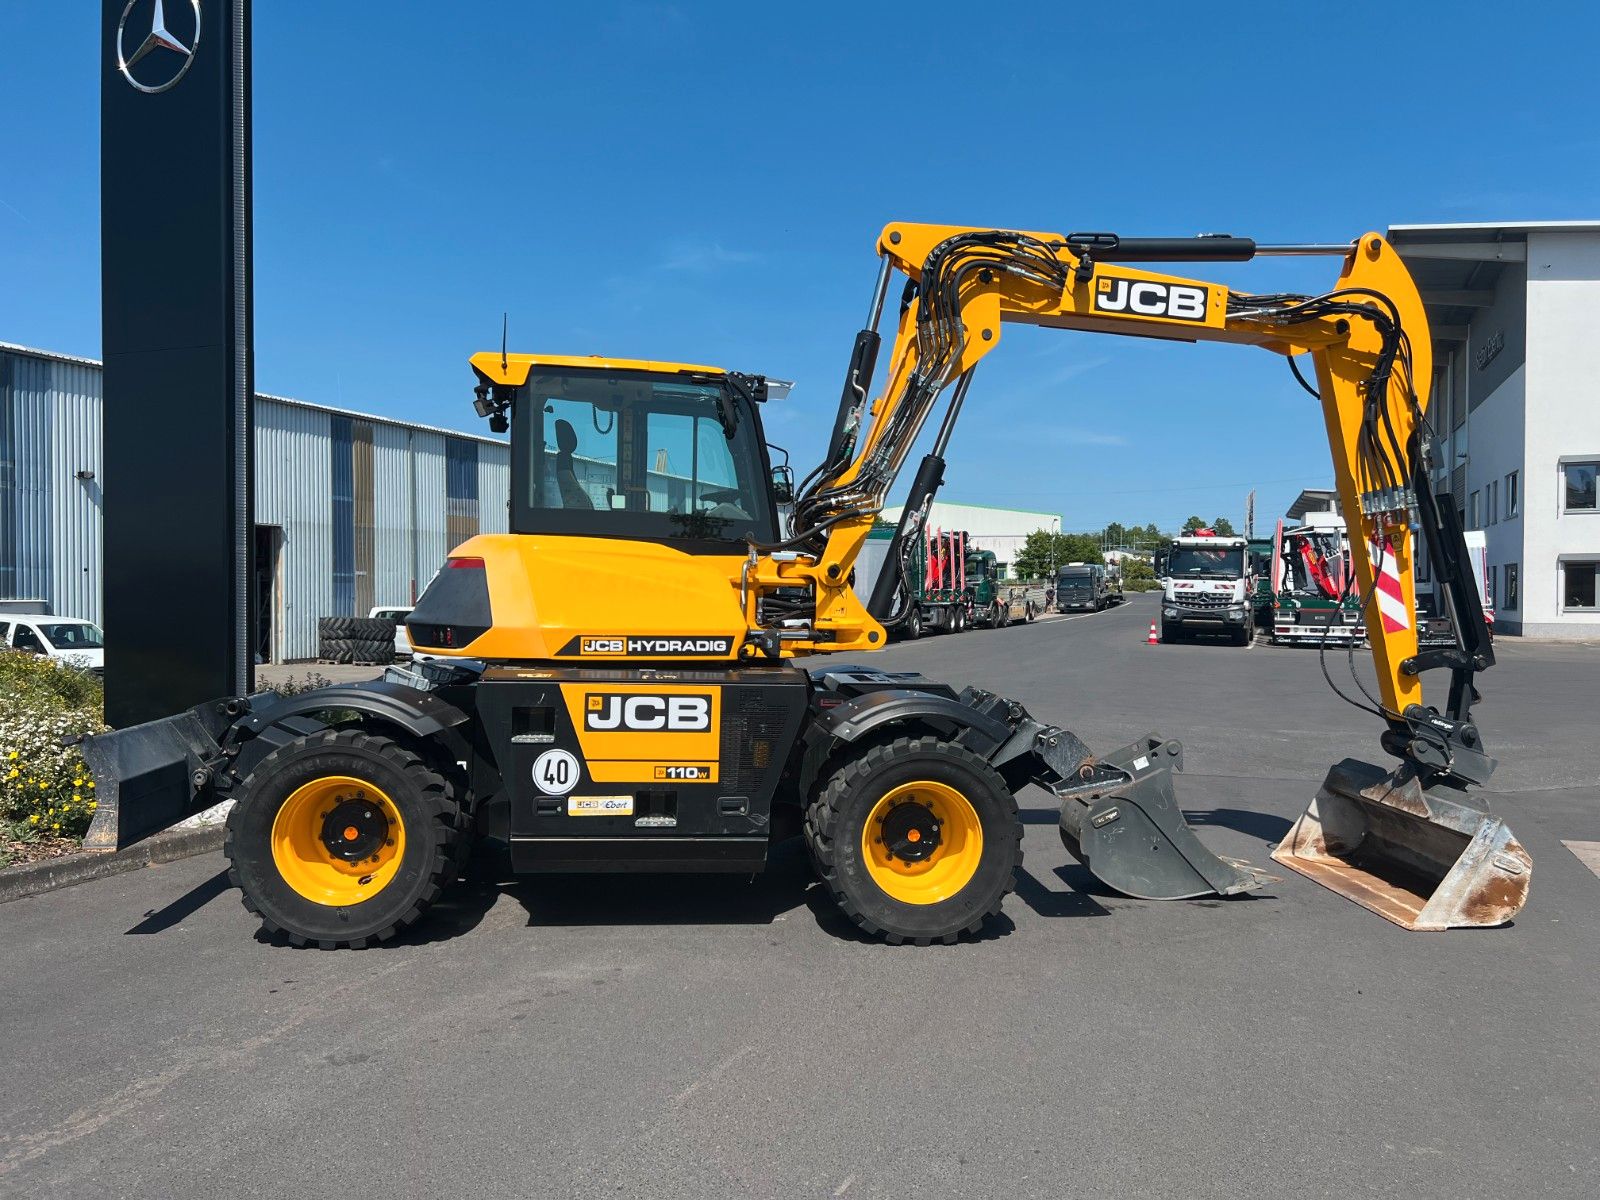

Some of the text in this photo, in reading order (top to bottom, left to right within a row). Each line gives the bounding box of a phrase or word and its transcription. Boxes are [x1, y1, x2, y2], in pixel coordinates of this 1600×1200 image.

[1097, 280, 1205, 319] JCB
[584, 640, 727, 652] JCB HYDRADIG
[587, 696, 709, 730] JCB
[543, 759, 569, 785] 40
[577, 800, 599, 809] JCB
